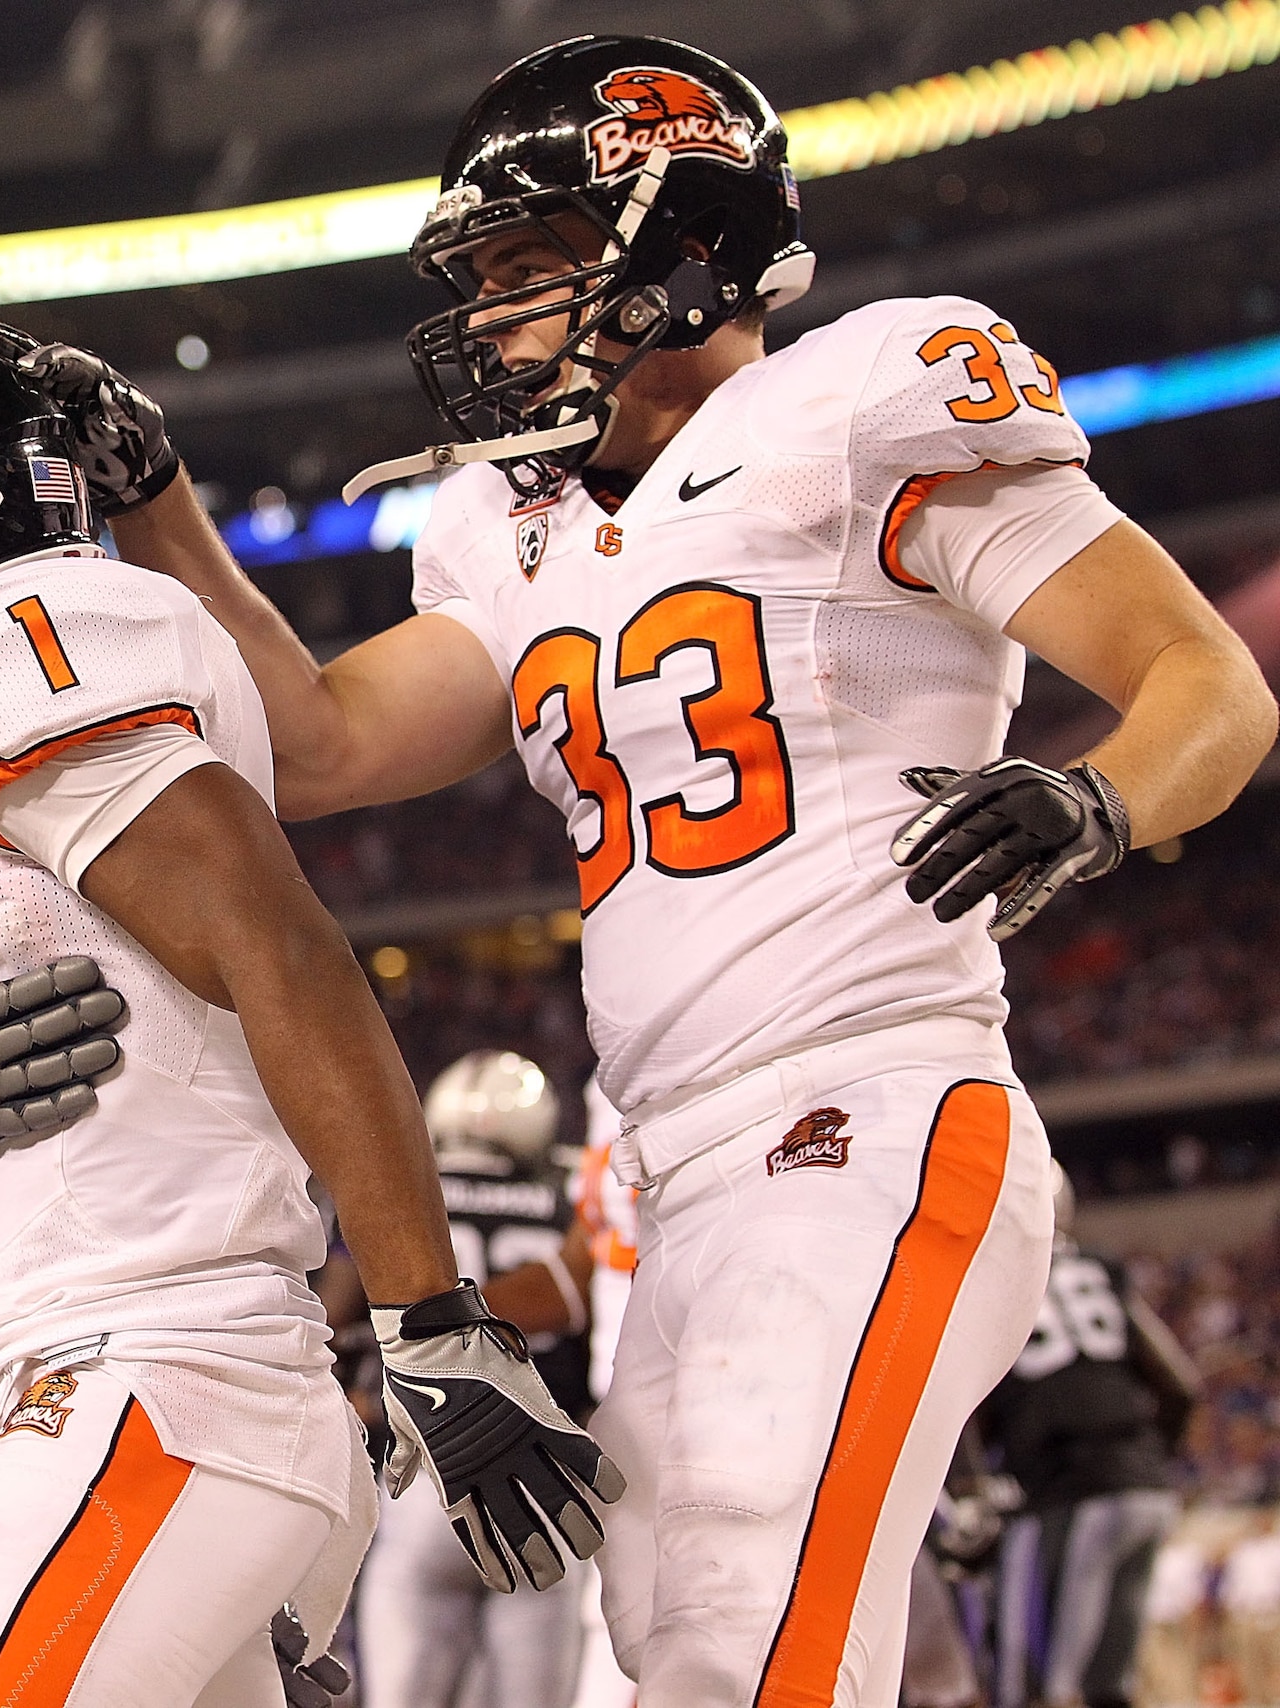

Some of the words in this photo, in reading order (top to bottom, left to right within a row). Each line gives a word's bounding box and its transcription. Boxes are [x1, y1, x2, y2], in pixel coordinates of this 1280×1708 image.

[916, 324, 1065, 424] 33
[5, 594, 81, 695] 1
[512, 578, 797, 921] 33
[769, 1139, 845, 1175] Beavers
